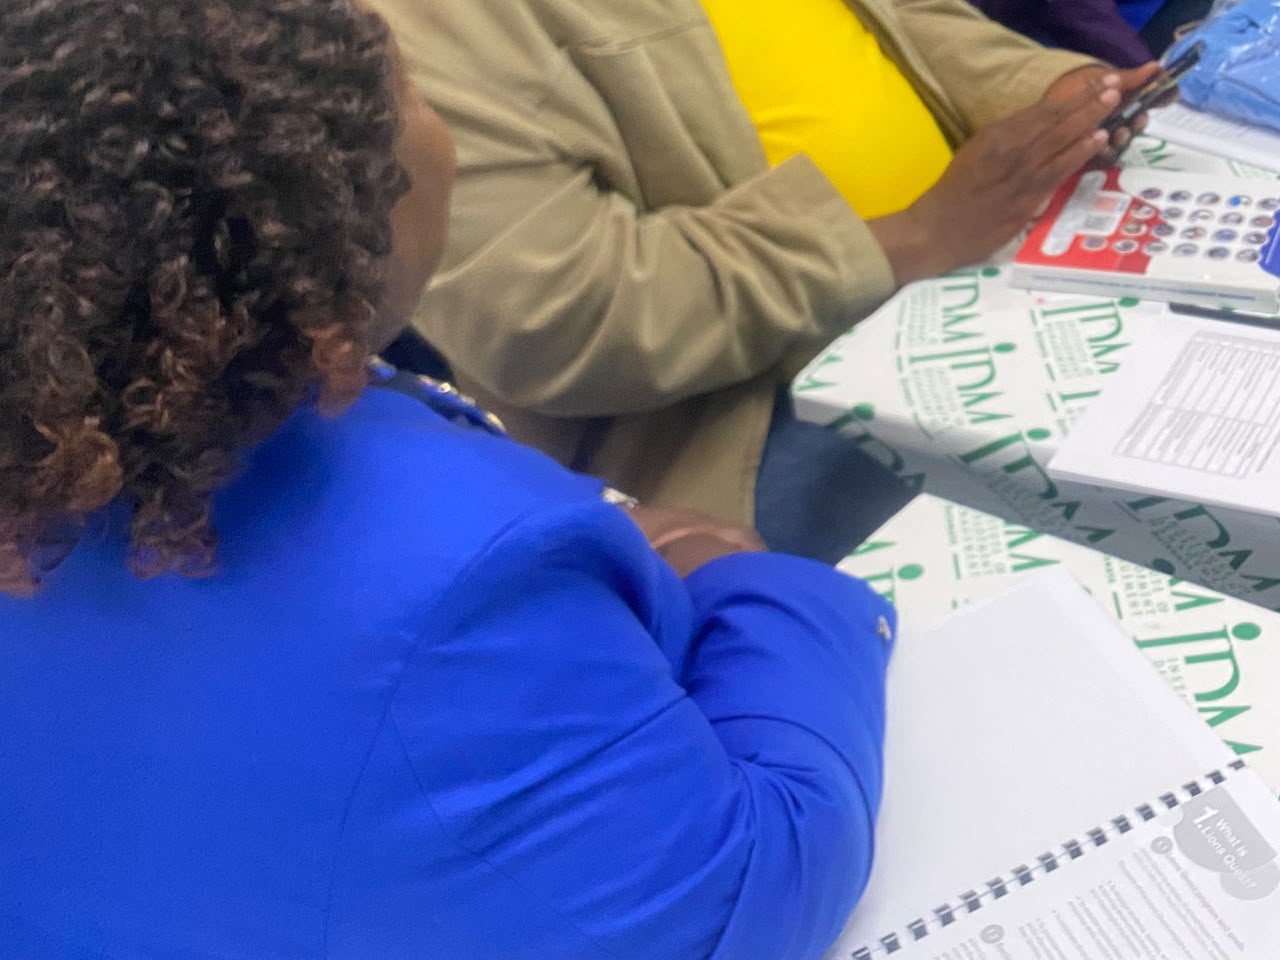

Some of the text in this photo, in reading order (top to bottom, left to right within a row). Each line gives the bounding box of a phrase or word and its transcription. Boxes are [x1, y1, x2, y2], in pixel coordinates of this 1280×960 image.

[1041, 296, 1140, 374] IDM
[909, 342, 1016, 424] IDM
[957, 427, 1116, 542] IDM
